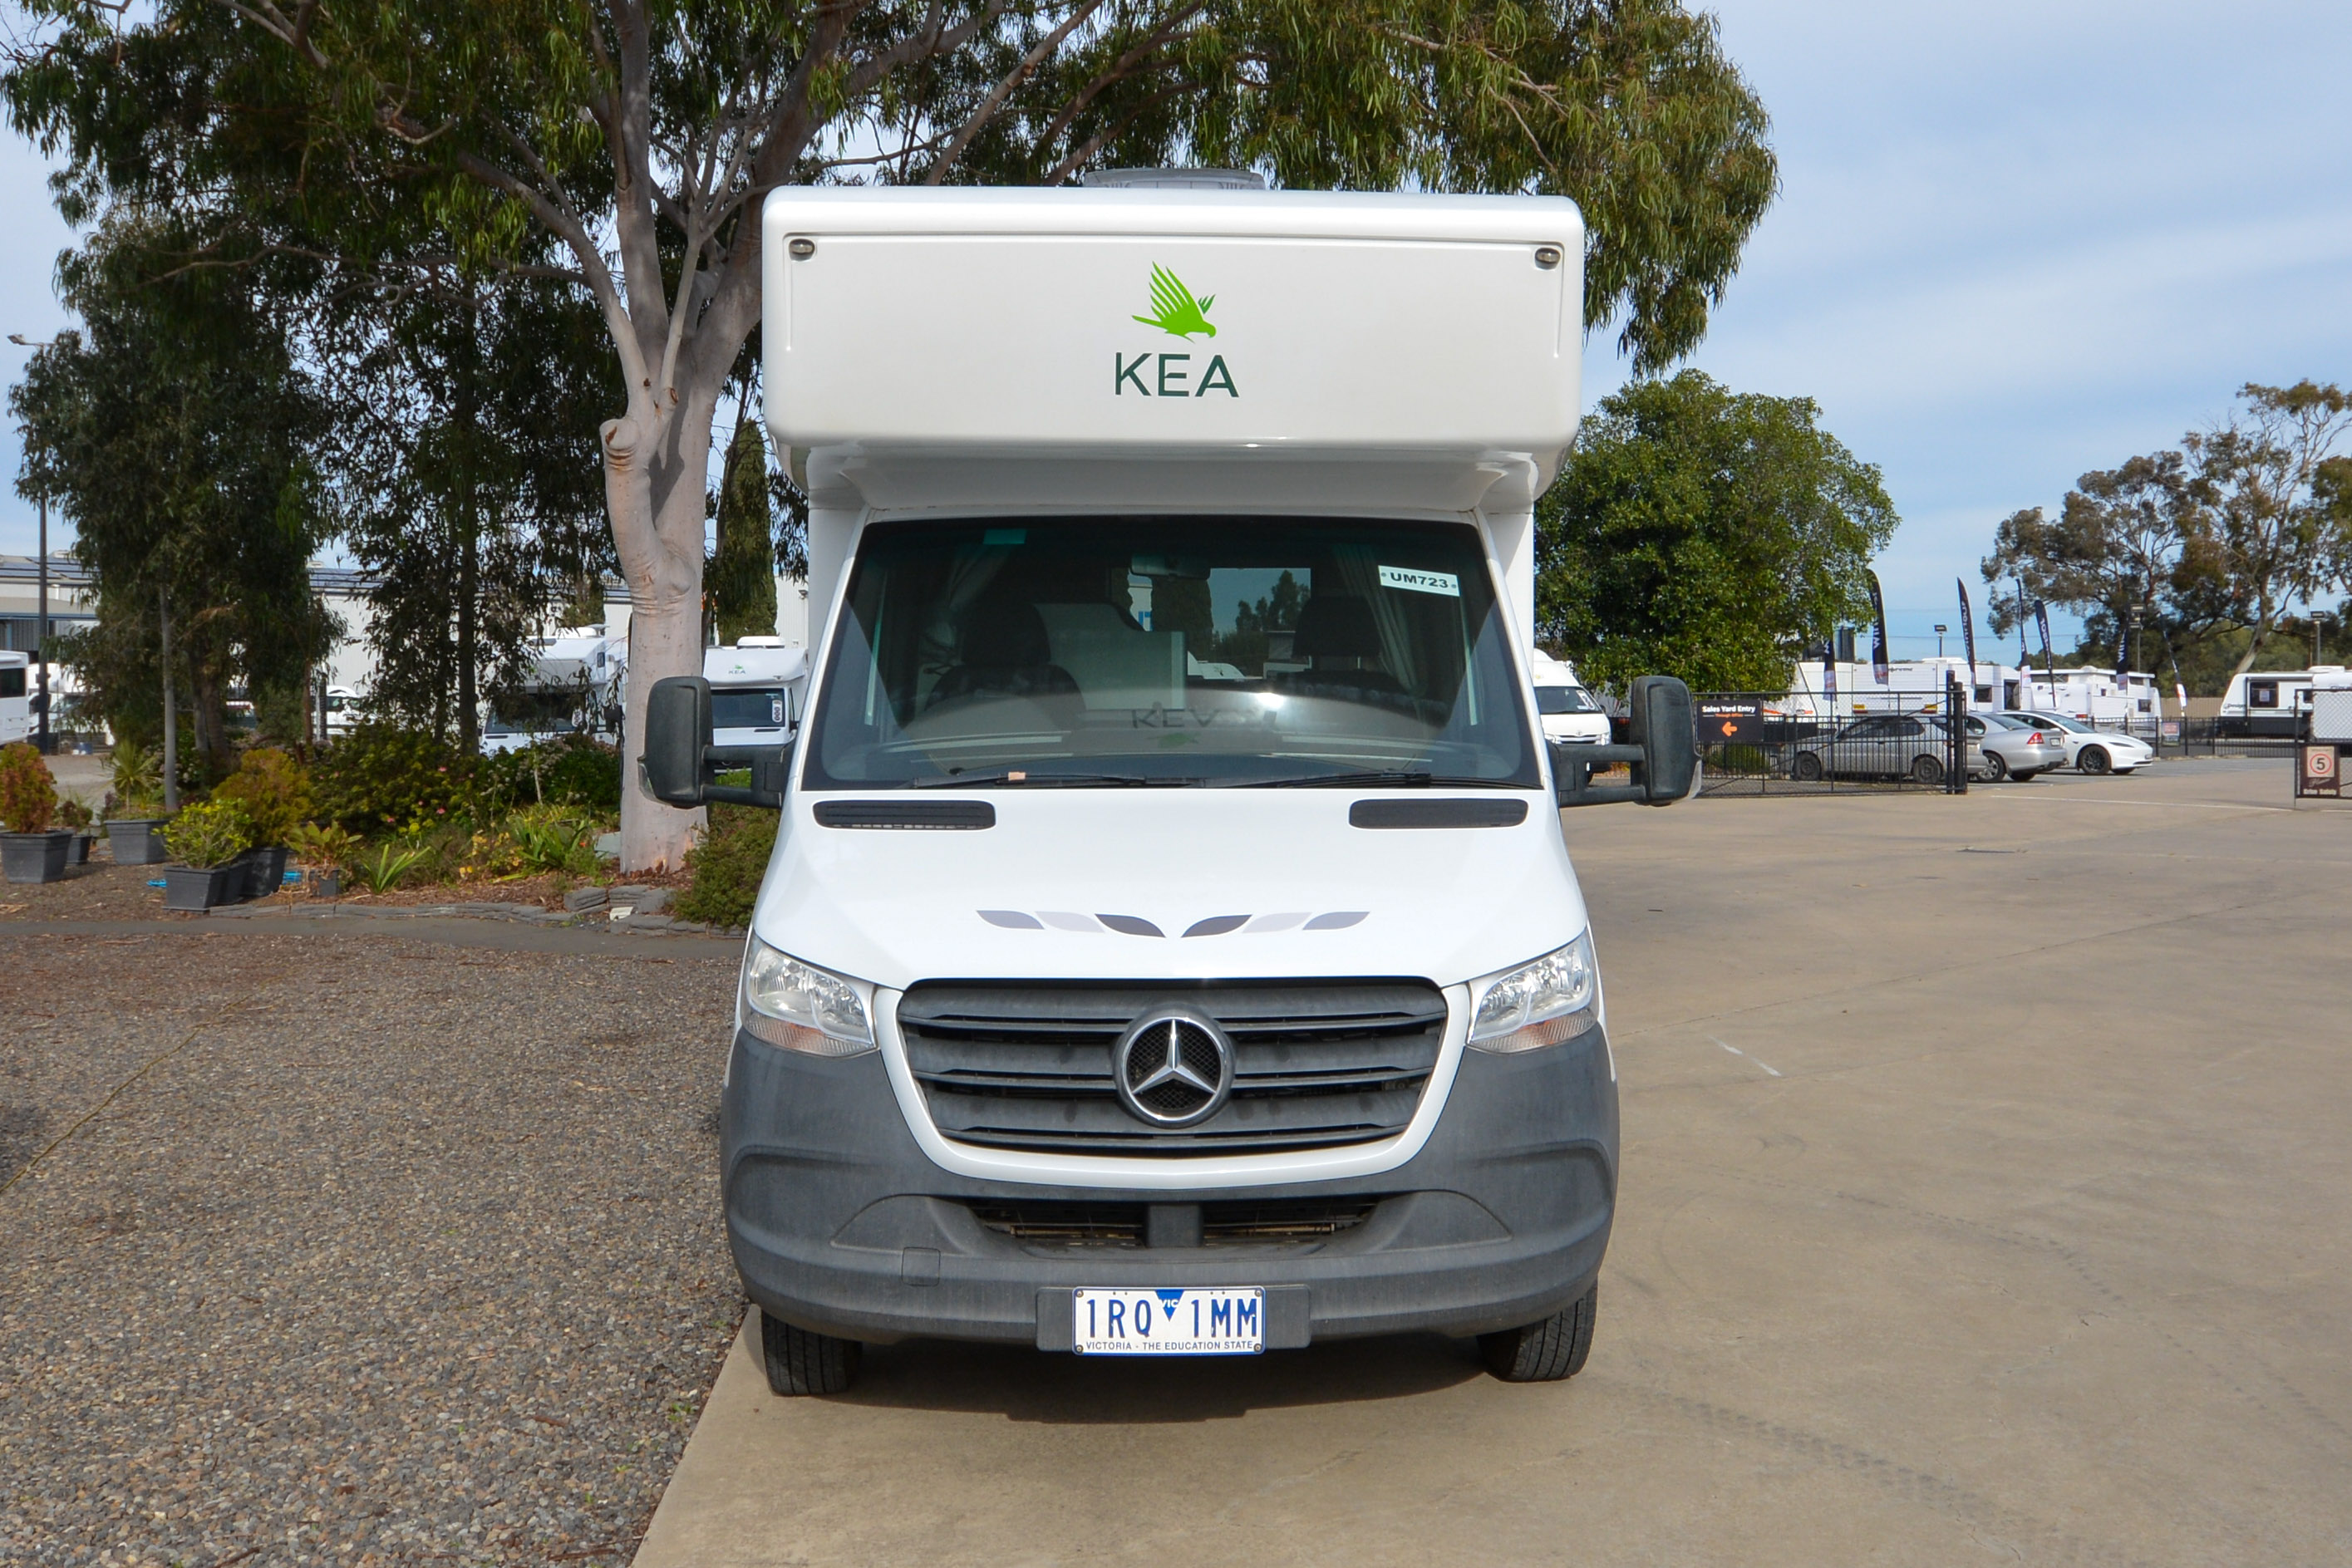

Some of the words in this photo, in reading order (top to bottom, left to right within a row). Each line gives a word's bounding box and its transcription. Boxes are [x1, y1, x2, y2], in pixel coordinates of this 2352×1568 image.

[1114, 351, 1240, 398] KEA
[1390, 572, 1449, 588] UM723
[2316, 757, 2325, 770] 5
[1163, 1299, 1180, 1308] VIC
[1087, 1299, 1152, 1338] 1RQ
[1191, 1298, 1257, 1338] 1MM
[1086, 1341, 1132, 1350] VICTORIA
[1143, 1341, 1161, 1350] THE
[1164, 1341, 1220, 1350] EDUCATION
[1224, 1340, 1252, 1349] STATE
